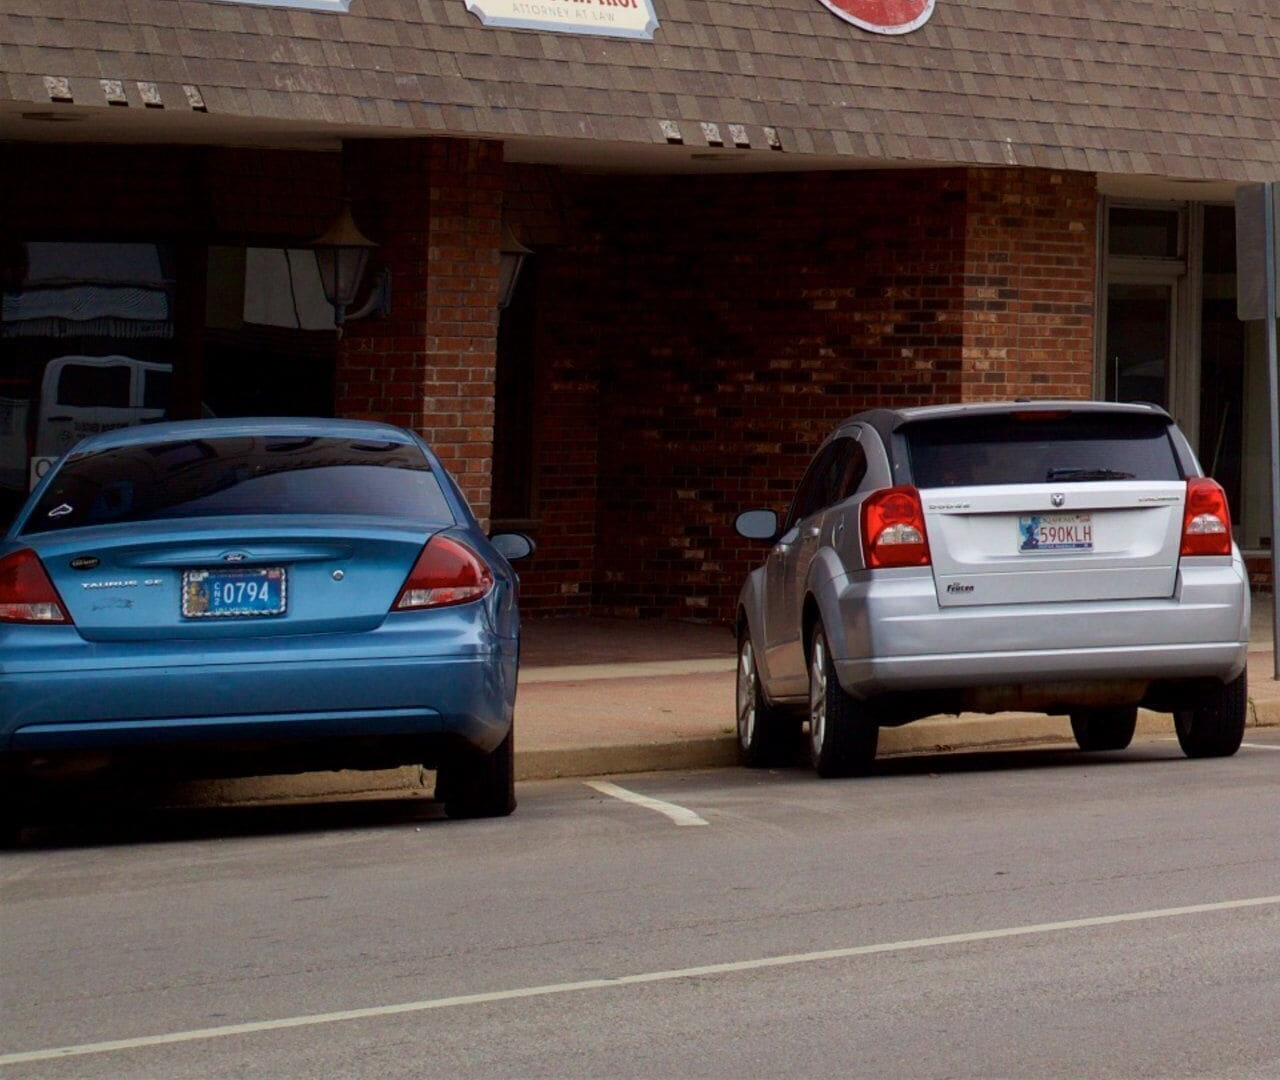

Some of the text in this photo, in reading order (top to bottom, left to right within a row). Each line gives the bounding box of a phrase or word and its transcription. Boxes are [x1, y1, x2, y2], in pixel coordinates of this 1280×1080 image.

[512, 3, 615, 22] ATTORNEY AT LAW
[1040, 526, 1092, 543] 590KLH
[223, 581, 269, 604] 0794
